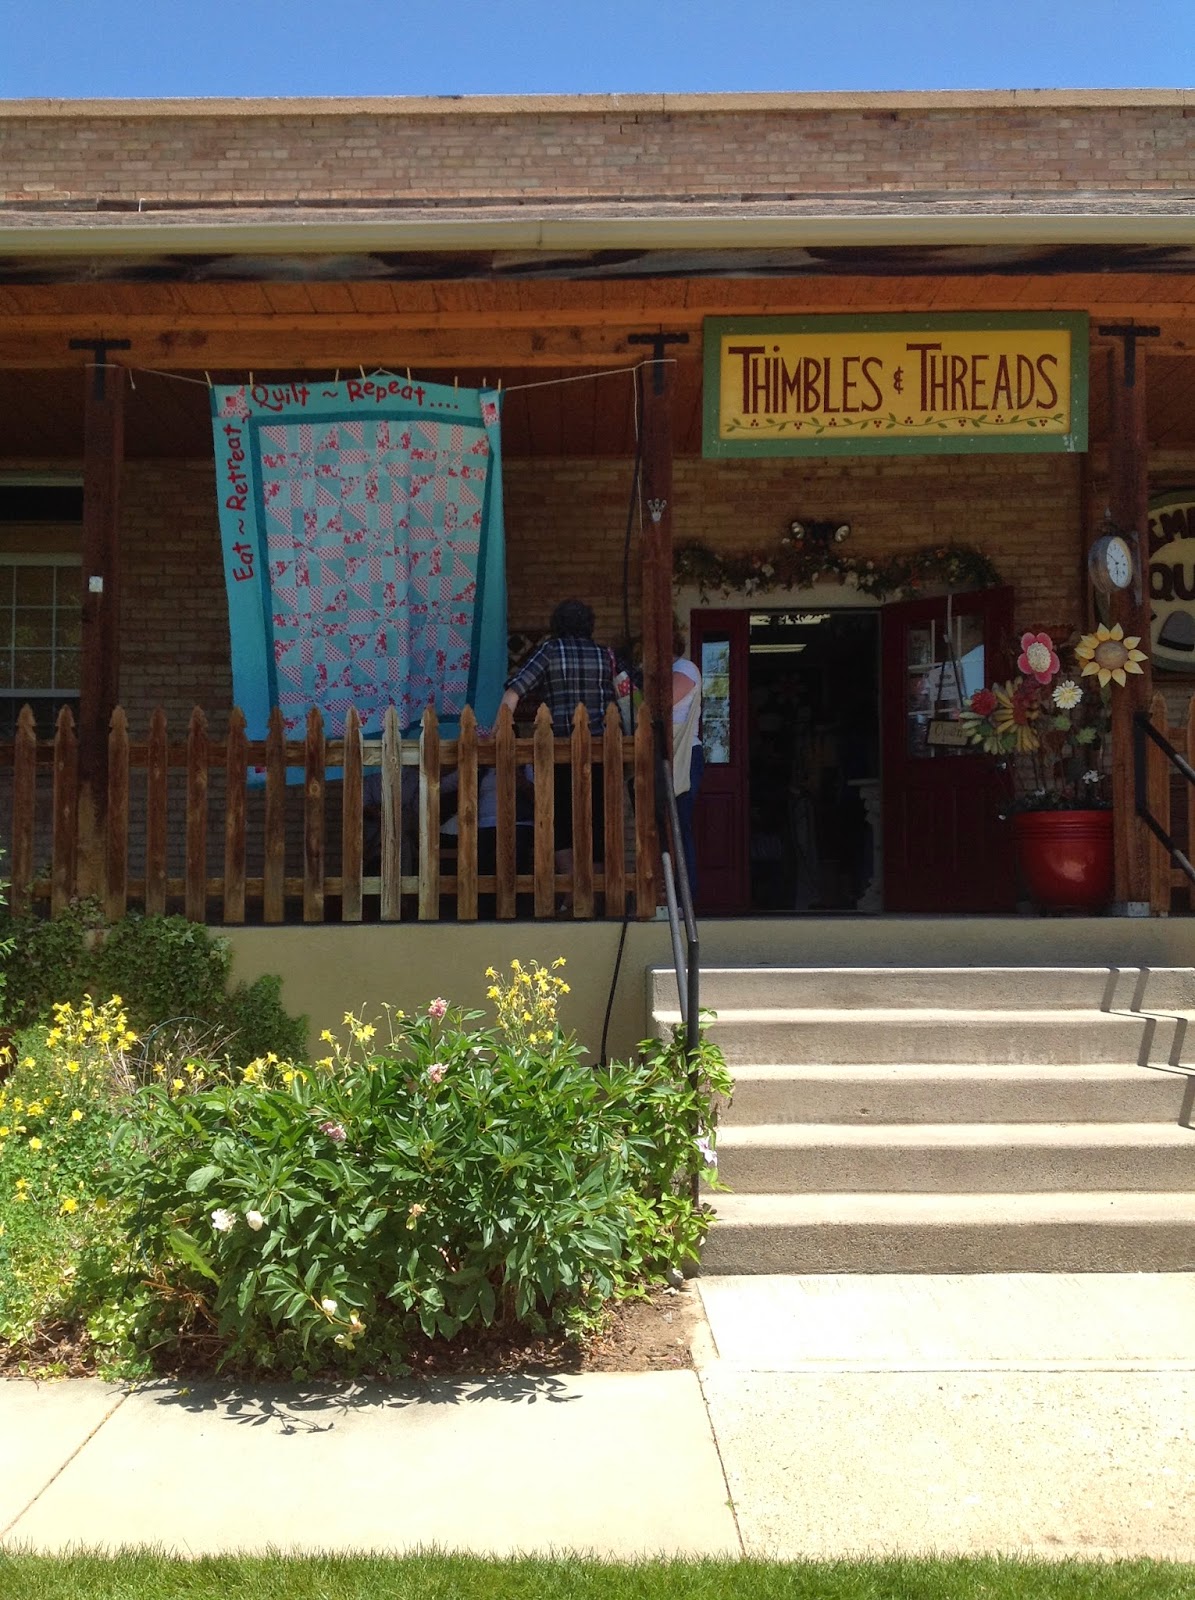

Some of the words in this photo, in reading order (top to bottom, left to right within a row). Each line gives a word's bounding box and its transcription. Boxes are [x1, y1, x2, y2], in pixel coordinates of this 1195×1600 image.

[251, 382, 311, 412] Quilt
[893, 365, 905, 395] &
[906, 342, 1059, 412] THREADS
[223, 423, 249, 512] Retreat
[232, 541, 255, 583] Eat
